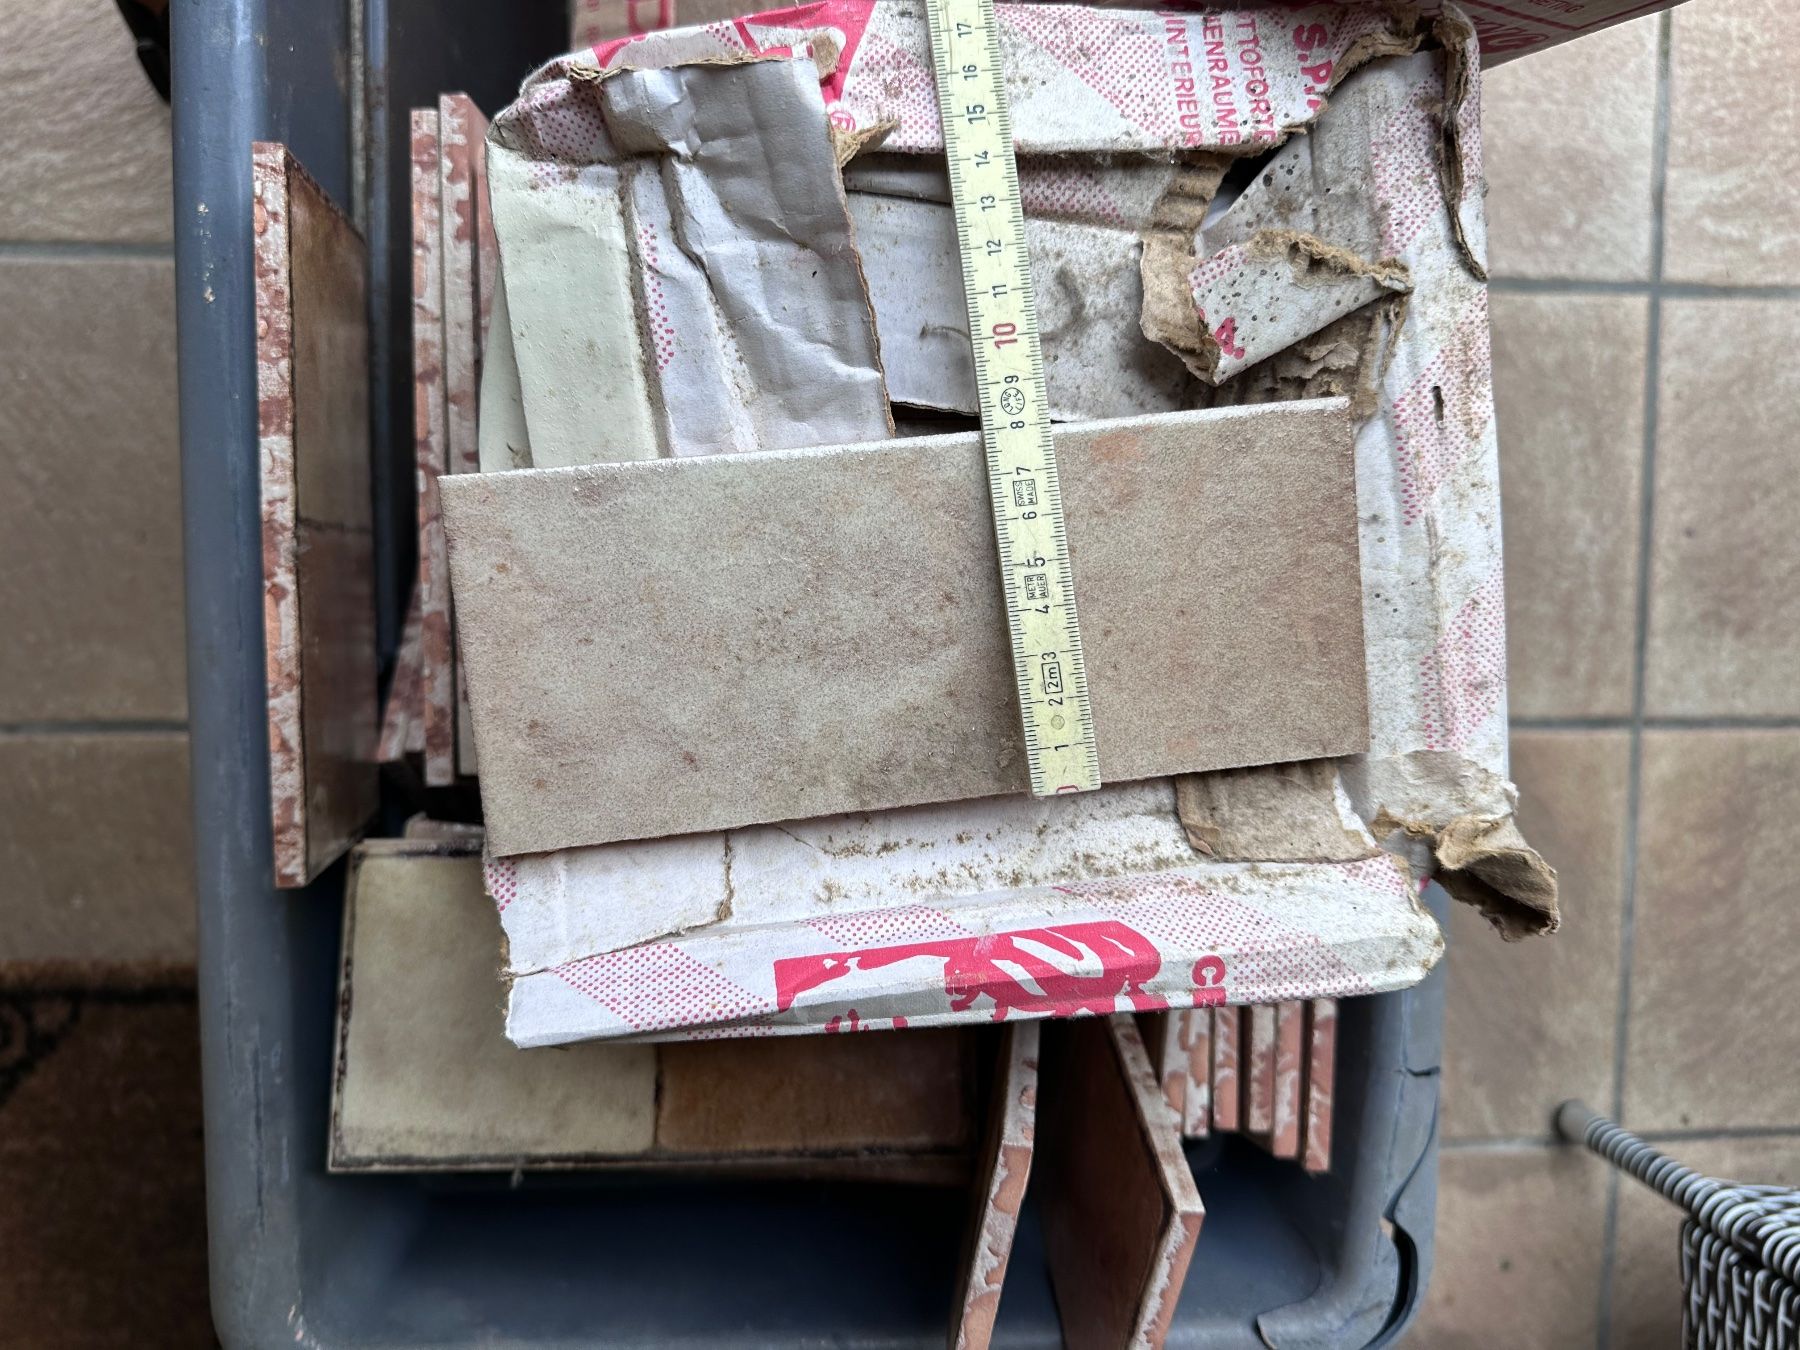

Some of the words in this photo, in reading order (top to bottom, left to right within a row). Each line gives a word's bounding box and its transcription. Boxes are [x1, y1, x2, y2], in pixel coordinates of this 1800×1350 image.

[956, 22, 973, 38] 17
[962, 64, 979, 81] 16
[966, 104, 986, 125] 15
[974, 150, 991, 168] 14
[980, 195, 996, 212] 13
[986, 239, 1002, 256] 12
[991, 284, 1008, 298] 11
[992, 322, 1018, 349] 10
[1004, 375, 1020, 384] 9
[1010, 420, 1025, 429] 8
[1016, 466, 1032, 475] 7
[1015, 481, 1026, 506] SWISS
[1025, 481, 1035, 505] MADE
[1022, 511, 1037, 520] 6
[1027, 557, 1046, 568] 5
[1035, 604, 1050, 614] 4
[1041, 651, 1057, 661] 3
[1048, 697, 1064, 706] 2
[1054, 744, 1070, 752] 1
